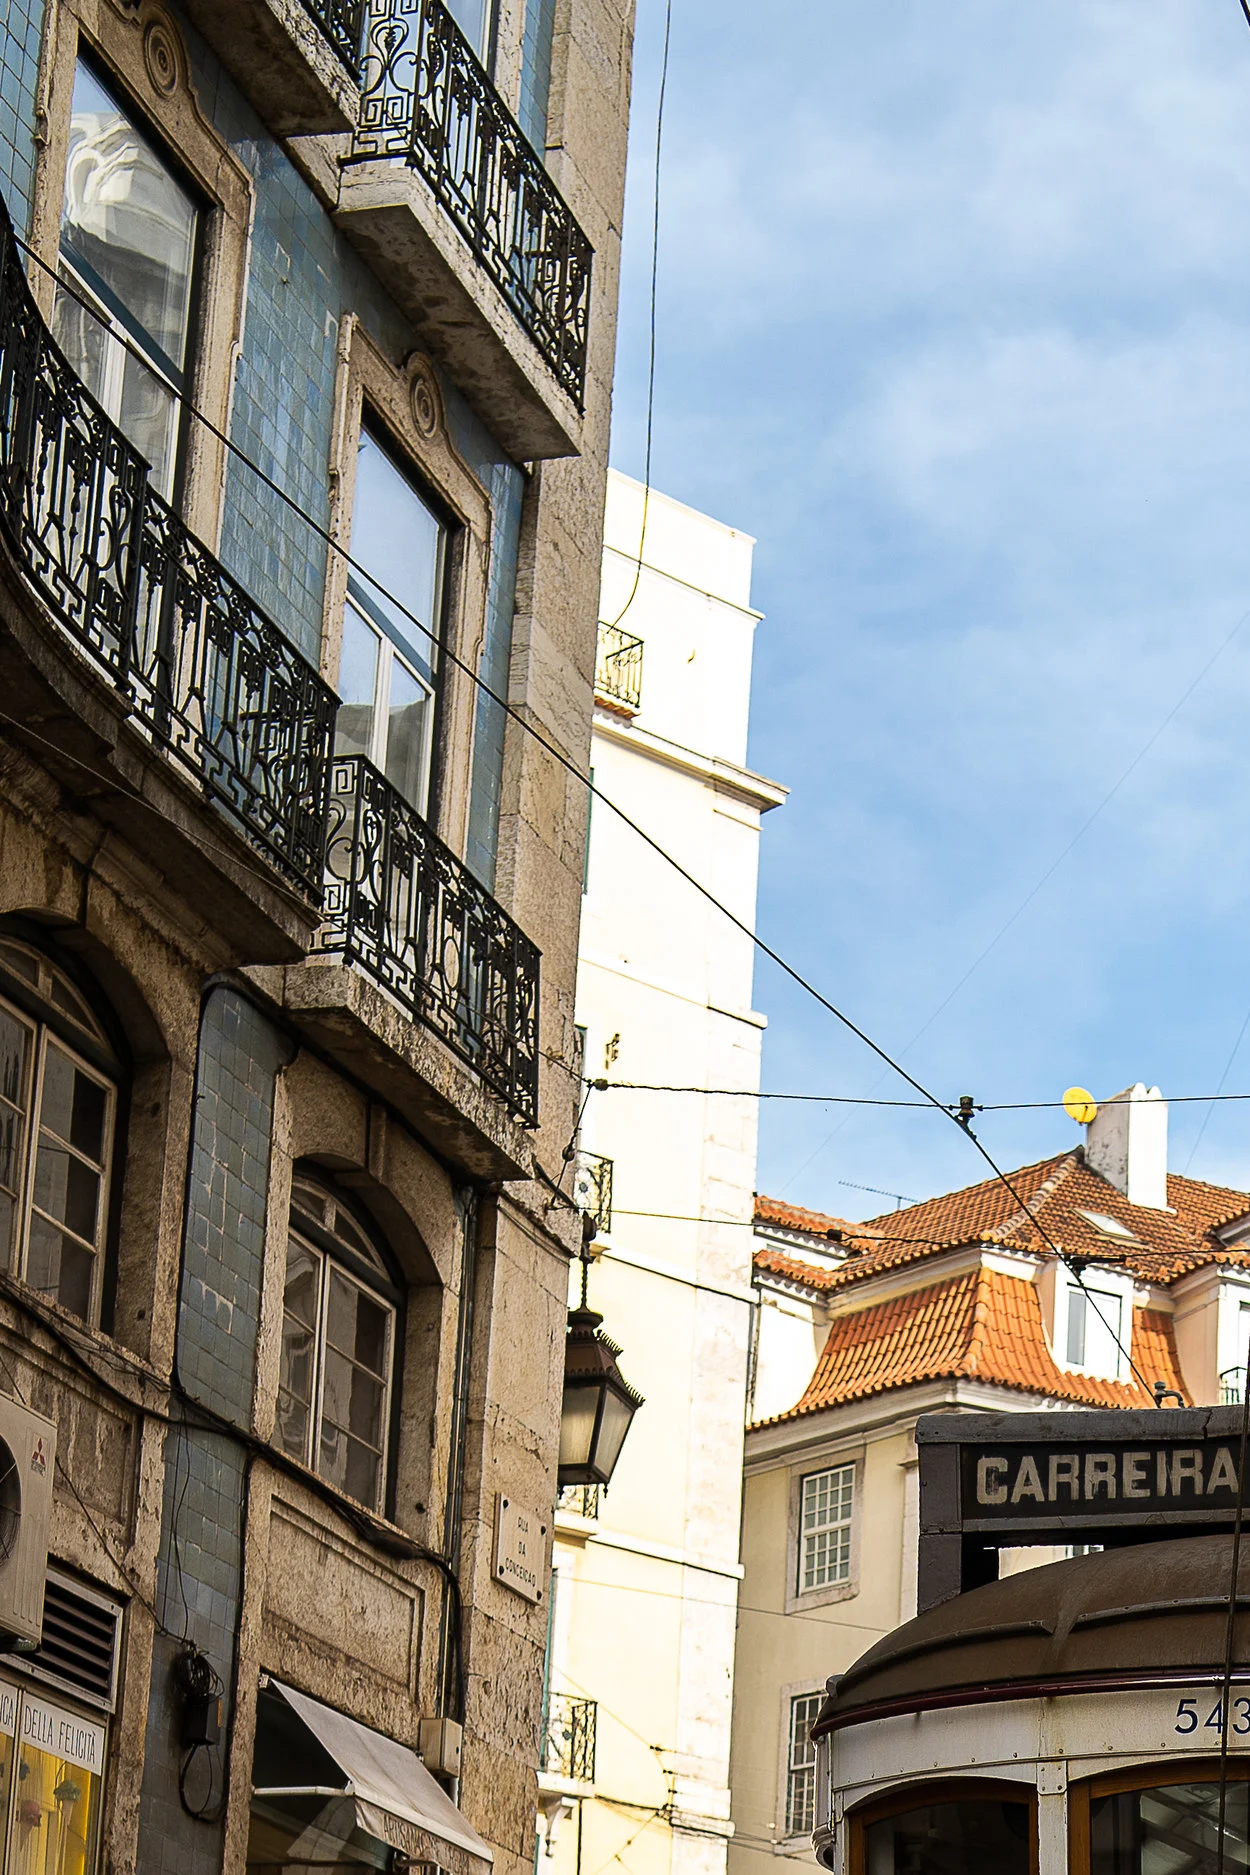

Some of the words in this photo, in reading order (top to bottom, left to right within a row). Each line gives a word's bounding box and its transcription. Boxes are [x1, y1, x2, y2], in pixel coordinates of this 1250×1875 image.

[976, 1446, 1239, 1505] CARREIRA
[23, 1704, 54, 1747] DELLA
[58, 1721, 97, 1765] FELICITÀ
